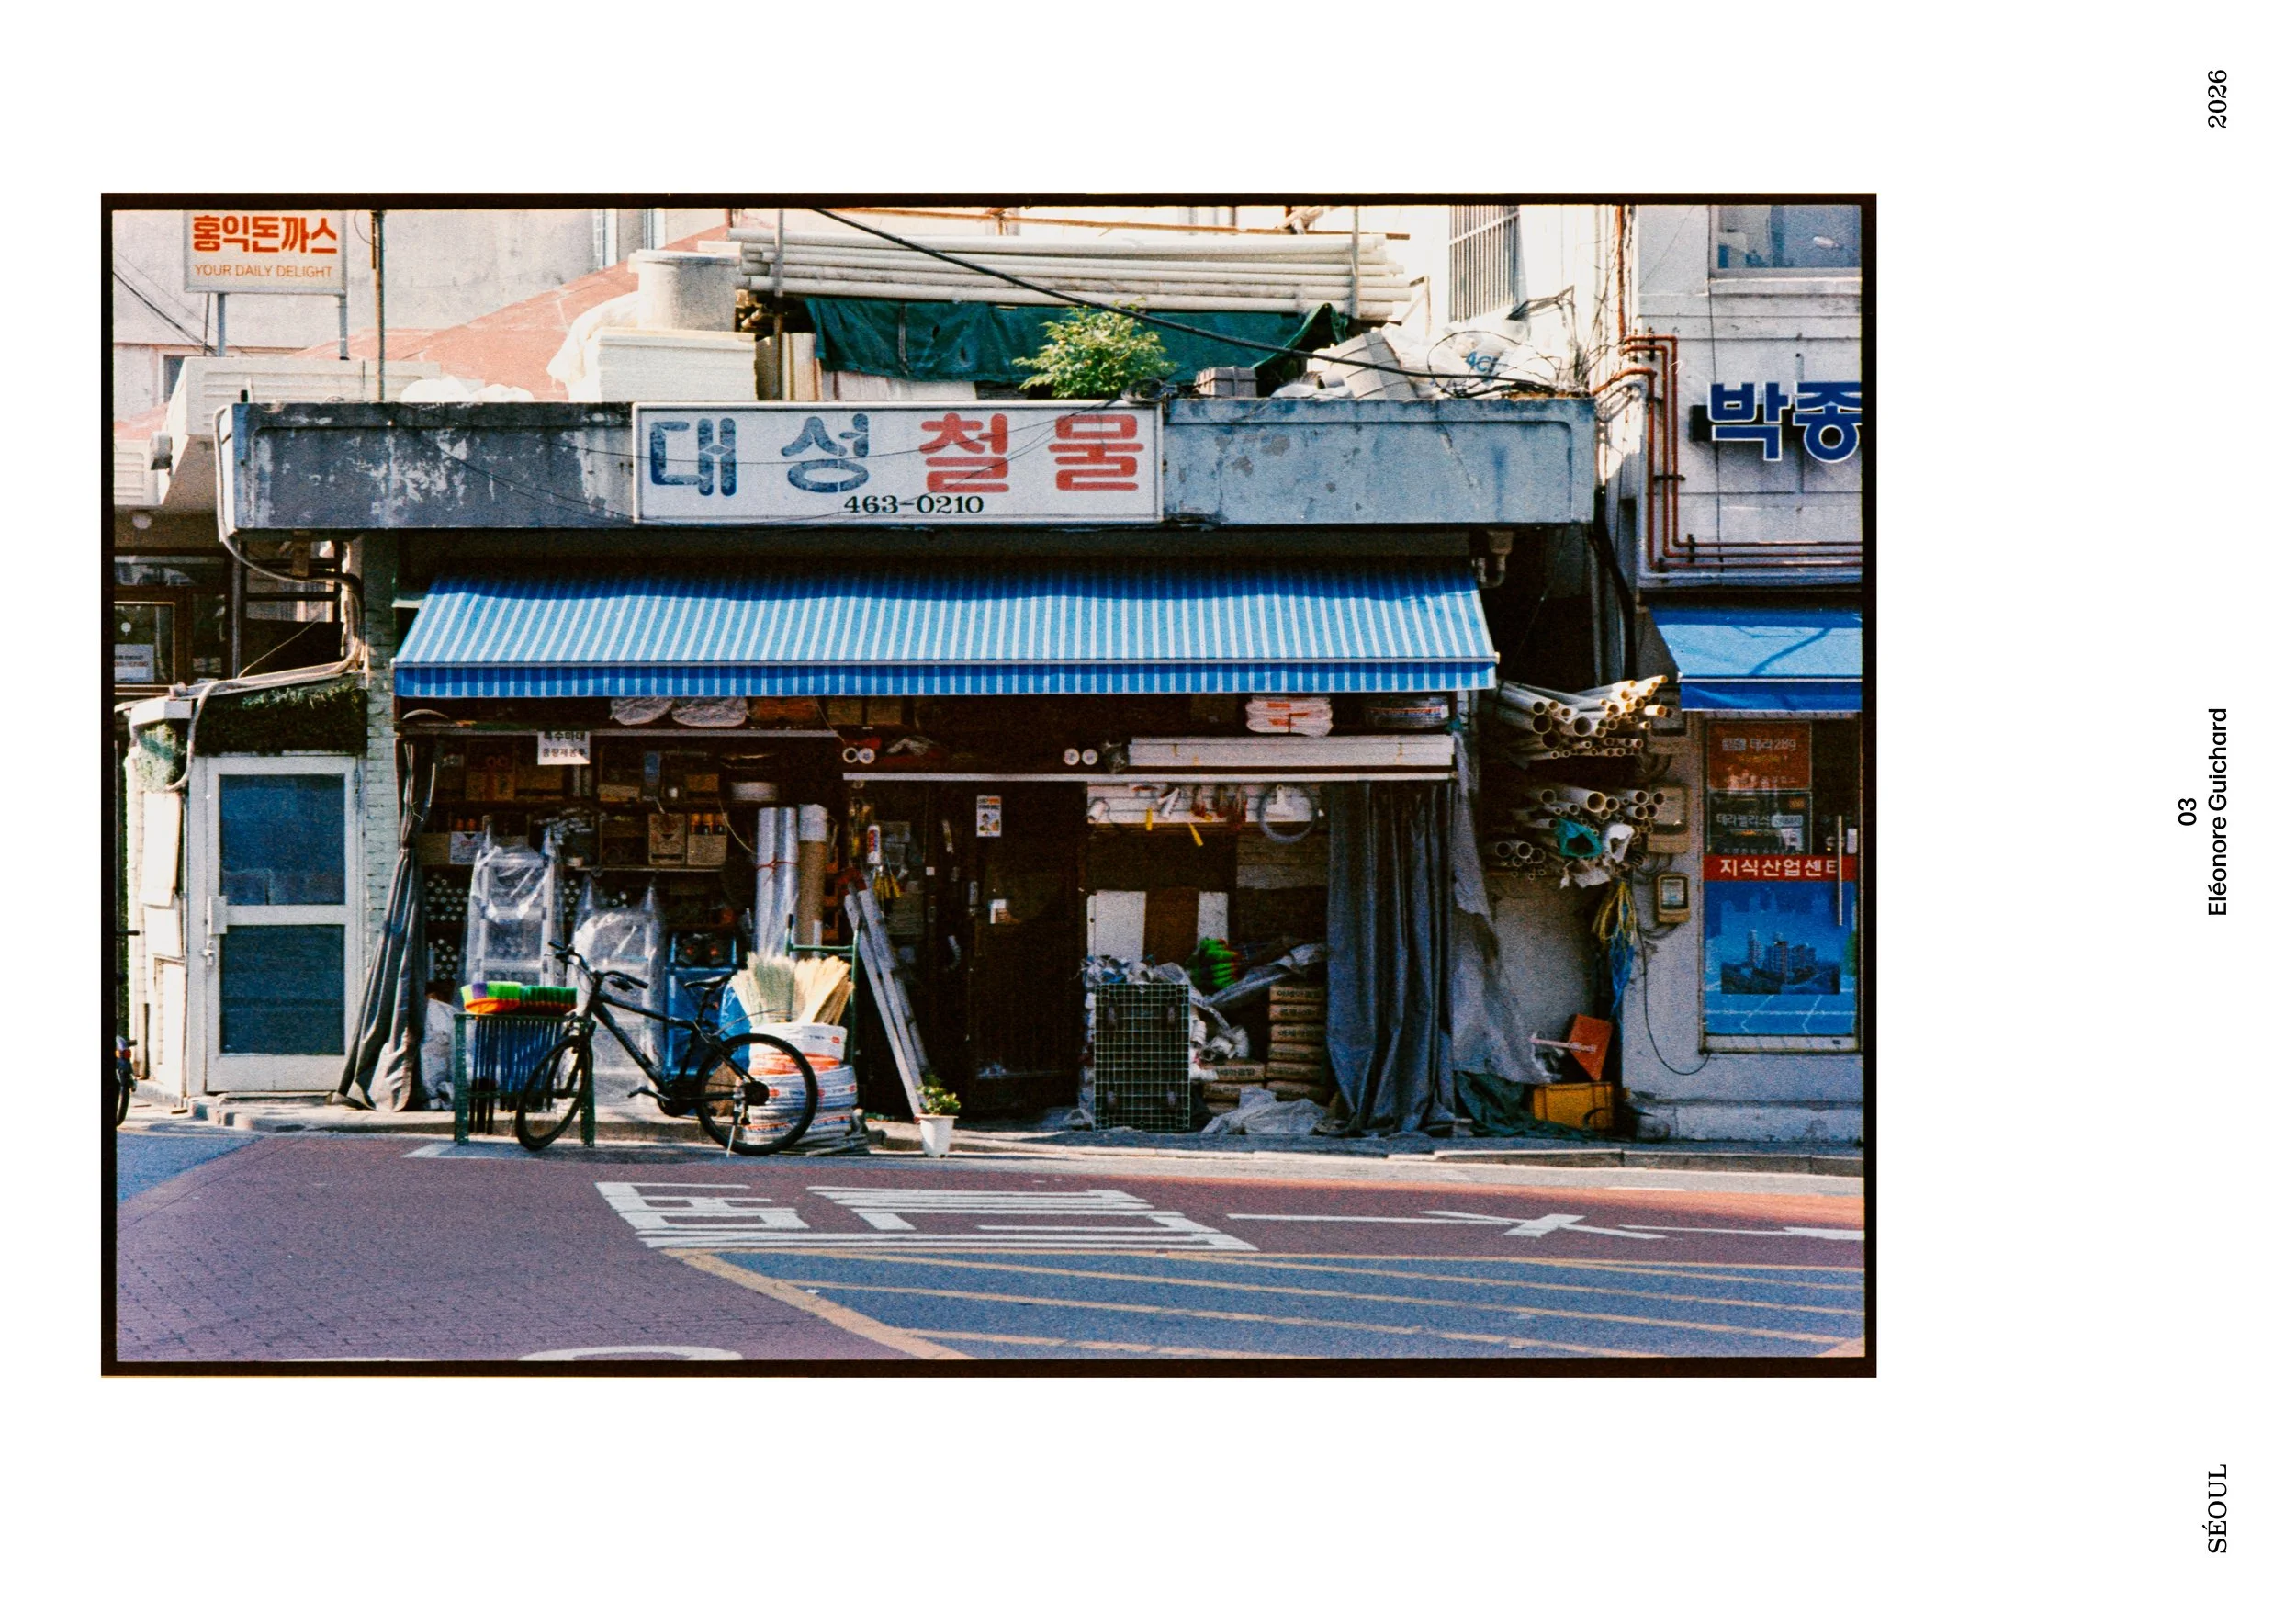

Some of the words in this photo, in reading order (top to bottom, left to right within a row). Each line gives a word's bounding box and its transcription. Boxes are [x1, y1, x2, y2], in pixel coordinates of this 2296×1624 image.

[193, 215, 337, 254] 홍익돈까스
[195, 264, 231, 276] YOUR
[235, 265, 273, 276] DAILY
[276, 265, 332, 277] DELIGHT
[1708, 382, 1862, 463] 박종
[650, 412, 1145, 497] 대성철물
[843, 494, 985, 514] 463-0210
